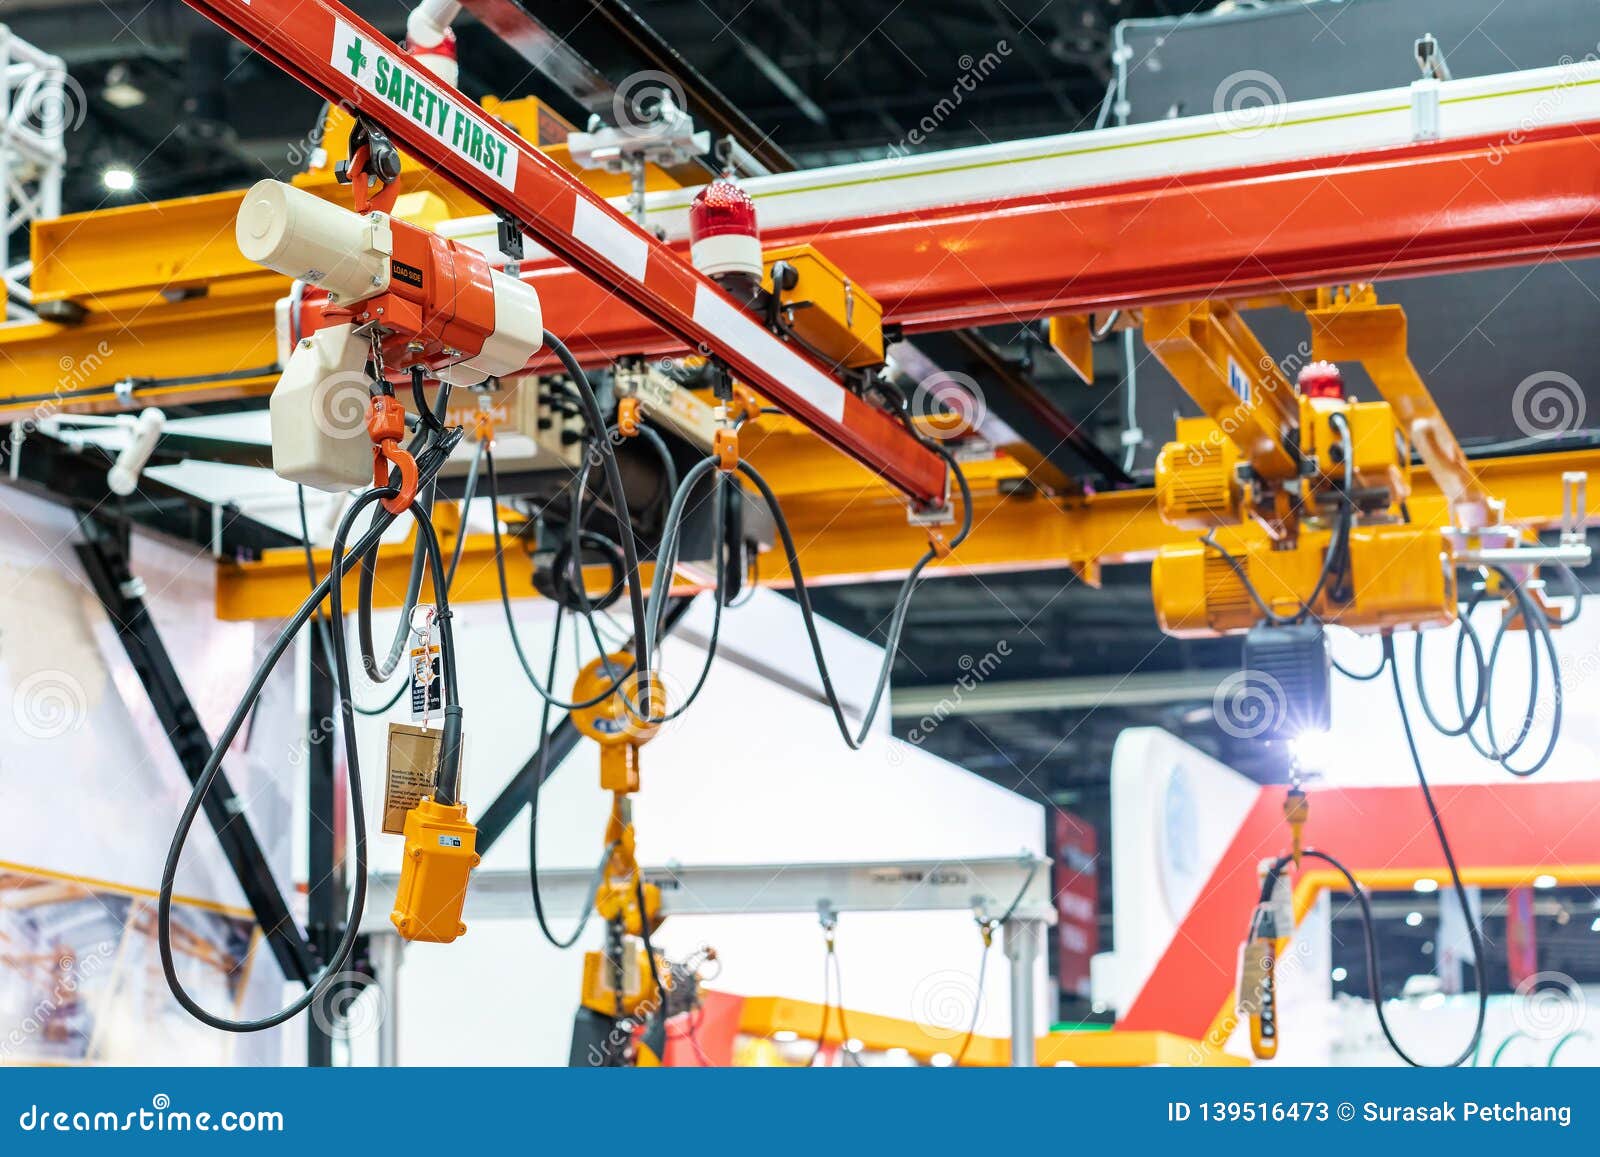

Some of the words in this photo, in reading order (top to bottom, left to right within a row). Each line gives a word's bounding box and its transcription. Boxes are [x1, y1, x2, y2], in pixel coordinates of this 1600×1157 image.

[375, 56, 450, 137] SAFETY
[452, 111, 508, 178] FIRST
[393, 265, 408, 277] LOAD
[409, 271, 422, 282] SIDE
